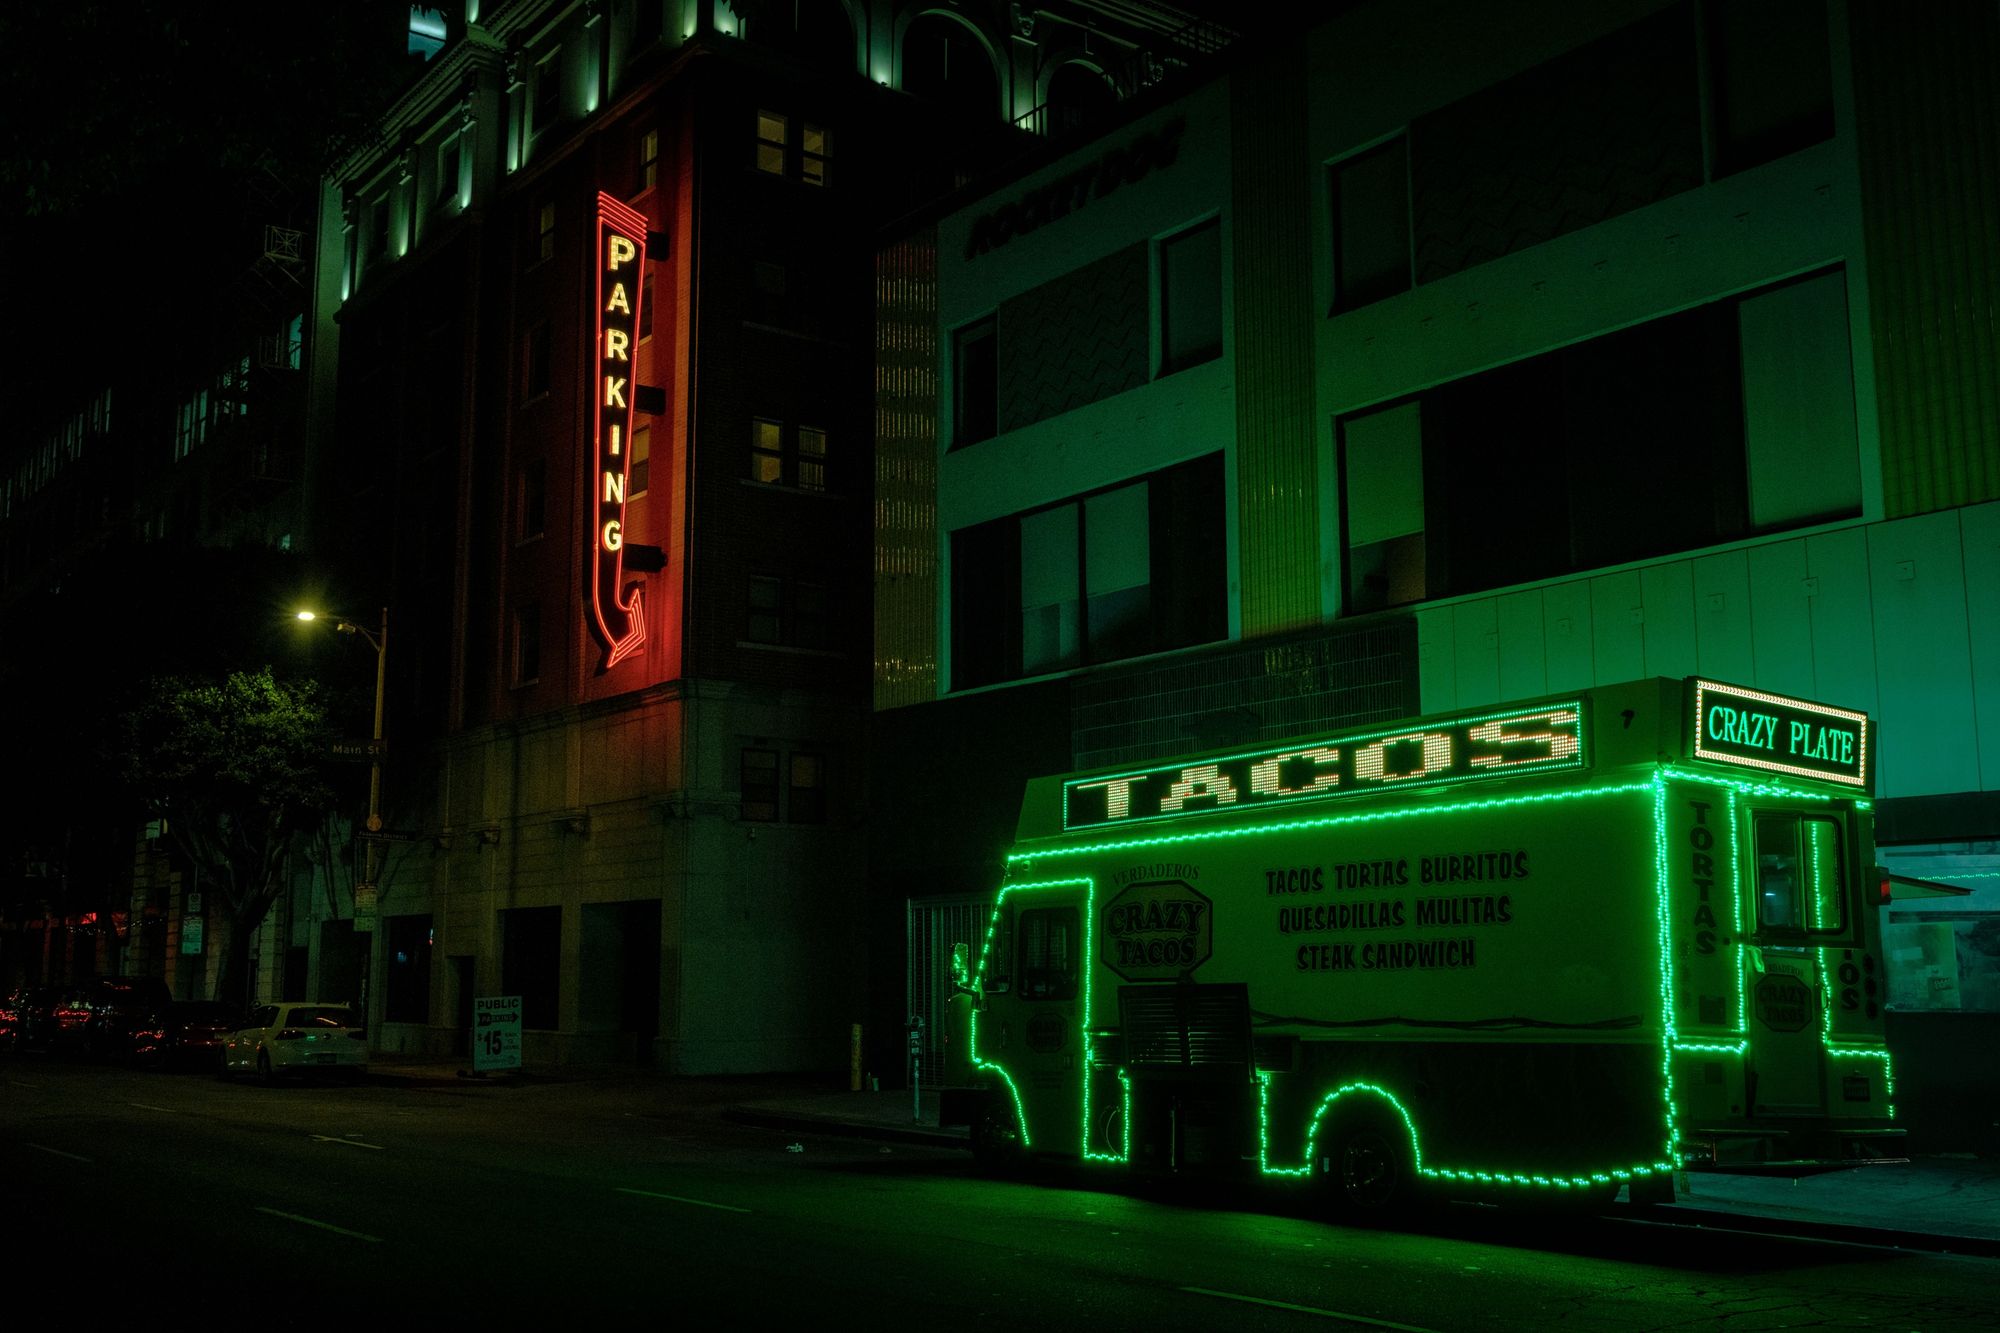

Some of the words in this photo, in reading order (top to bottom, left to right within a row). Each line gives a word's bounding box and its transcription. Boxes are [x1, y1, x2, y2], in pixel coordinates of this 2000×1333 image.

[602, 234, 635, 552] PARKING
[332, 744, 362, 754] Main
[1708, 705, 1778, 750] CRAZY
[1789, 721, 1854, 765] PLATE
[1076, 710, 1578, 819] TACOS
[1112, 863, 1200, 887] VERDADEROS
[1265, 865, 1324, 896] TACOS
[1334, 859, 1409, 890] TORTAS
[1419, 850, 1529, 884] BURRITOS
[1688, 800, 1717, 955] TORTAS
[1109, 901, 1204, 934] CRAZY
[1279, 900, 1406, 934] QUESADILLAS
[1415, 896, 1512, 927] MULITAS
[1118, 937, 1196, 966] TACOS
[1296, 944, 1356, 971] STEAK
[1361, 938, 1475, 969] SANDWICH
[477, 998, 519, 1010] PUBLIC
